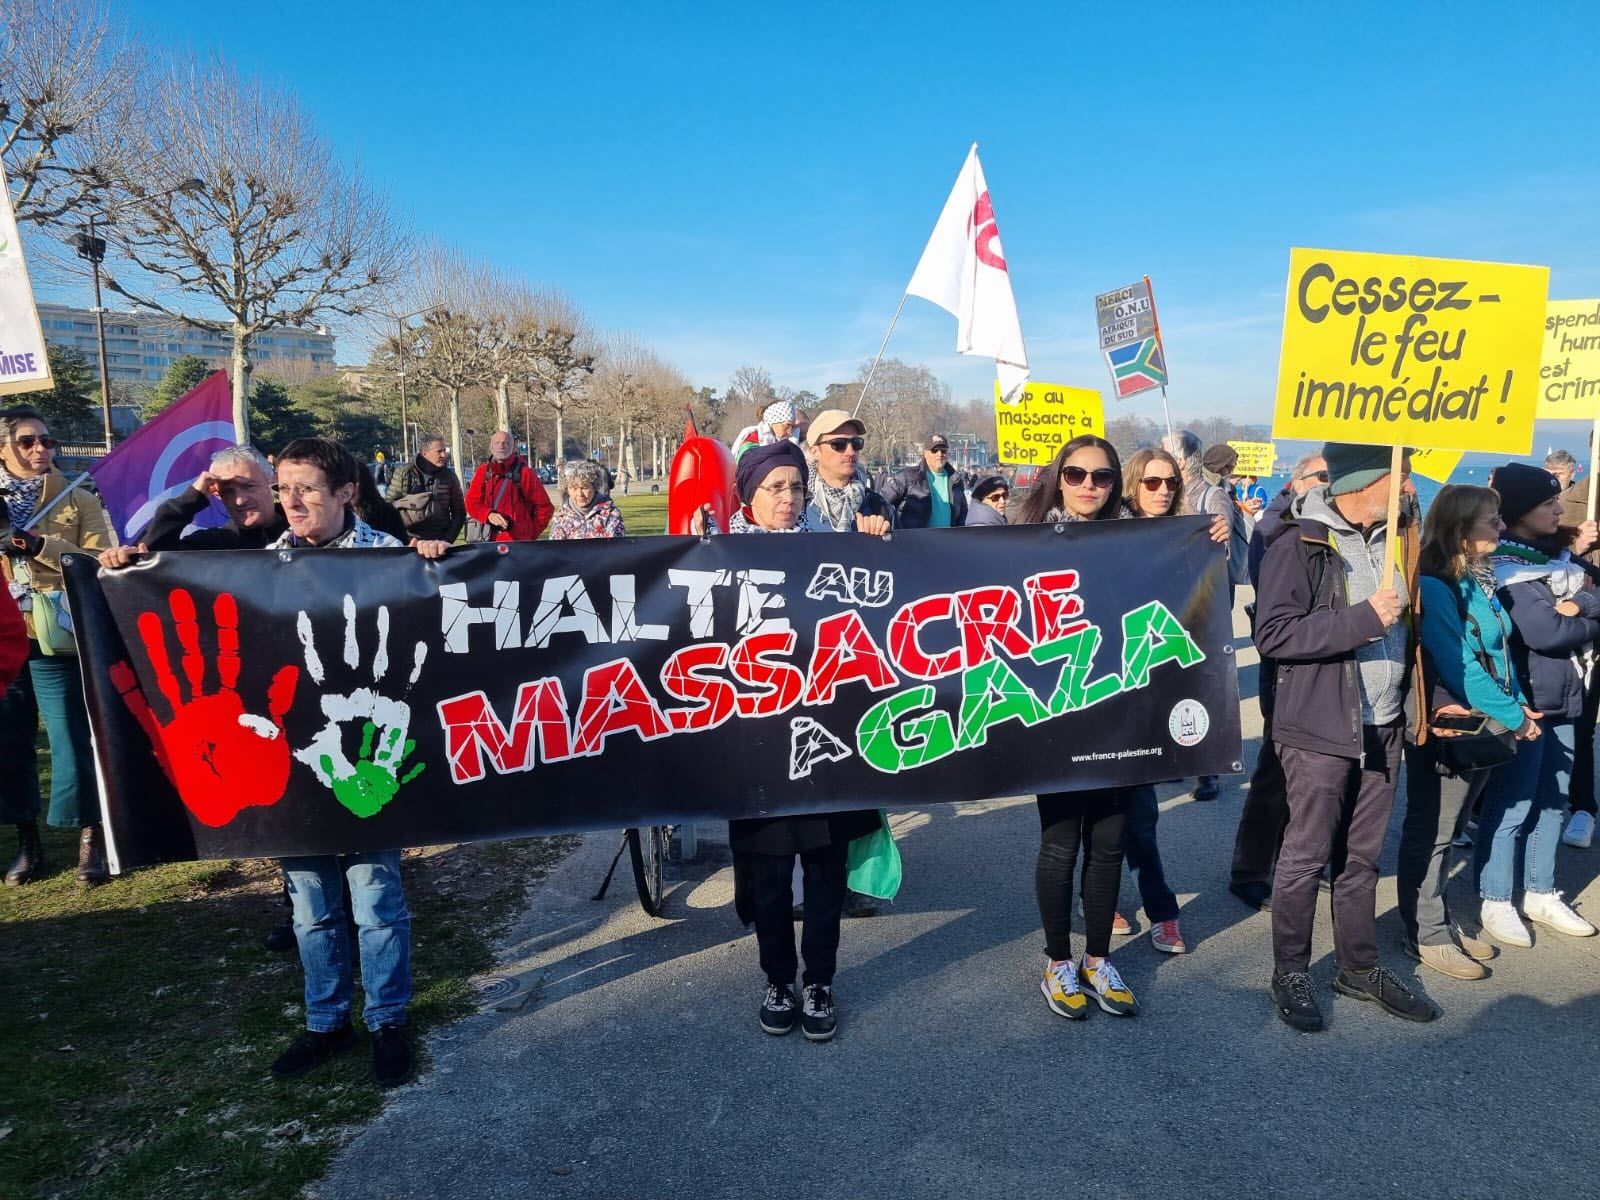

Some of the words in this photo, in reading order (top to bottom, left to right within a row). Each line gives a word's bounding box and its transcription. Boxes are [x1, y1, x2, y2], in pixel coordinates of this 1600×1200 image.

[1099, 288, 1133, 306] MERCI
[1102, 319, 1135, 335] AFRIQUE
[1104, 335, 1116, 345] DU
[1117, 329, 1135, 342] SUD
[1350, 315, 1387, 366] le
[1391, 313, 1467, 379] feu
[1540, 357, 1571, 379] est
[1044, 391, 1064, 405] au
[999, 411, 1076, 426] massacre
[1081, 409, 1092, 428] à
[1022, 428, 1062, 444] Gaza
[1003, 440, 1038, 464] Stop
[438, 568, 791, 654] HALTE
[805, 563, 894, 608] AU
[436, 569, 1091, 785] MASSACRE
[855, 600, 1206, 774] GAZA
[1072, 747, 1162, 763] www.france-palestine.org
